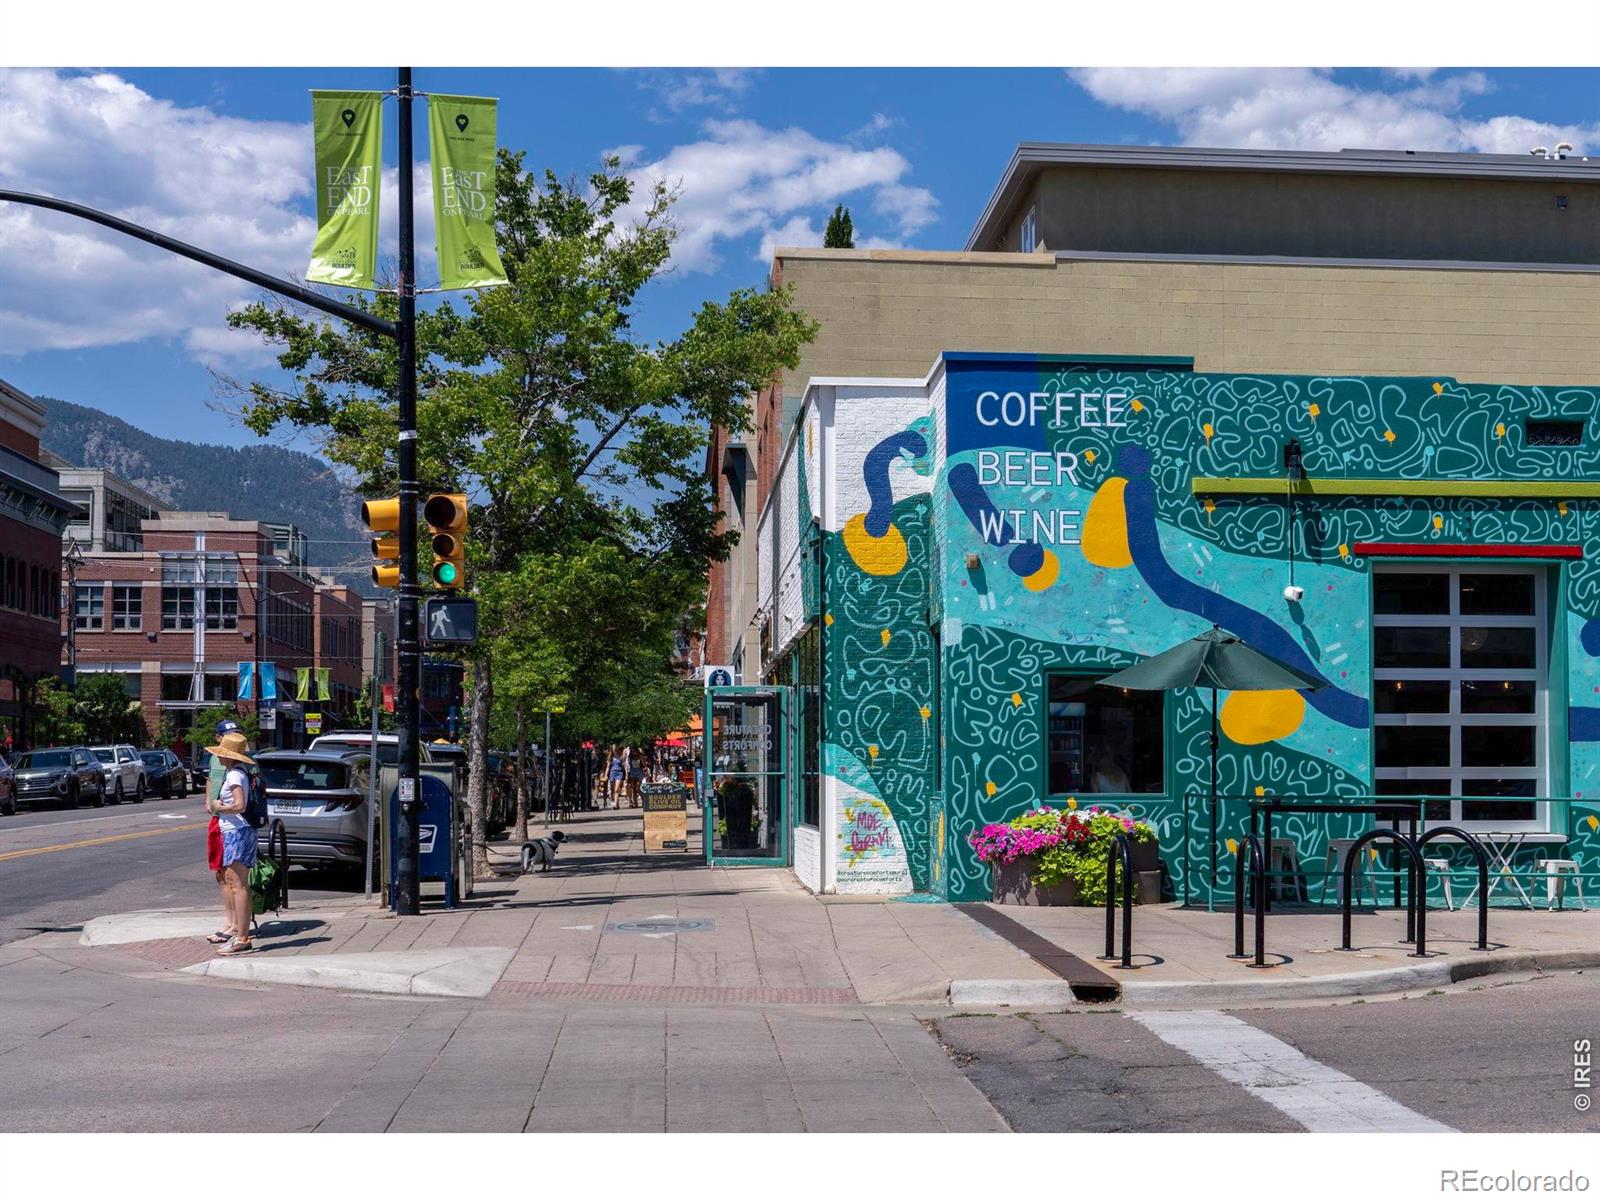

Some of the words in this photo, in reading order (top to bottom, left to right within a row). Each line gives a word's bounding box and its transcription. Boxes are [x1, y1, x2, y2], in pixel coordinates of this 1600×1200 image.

[327, 186, 371, 208] END
[442, 186, 486, 211] END
[442, 208, 457, 216] ON
[976, 391, 1127, 427] COFFEE
[978, 451, 1079, 486] BEER
[979, 509, 1081, 545] WINE
